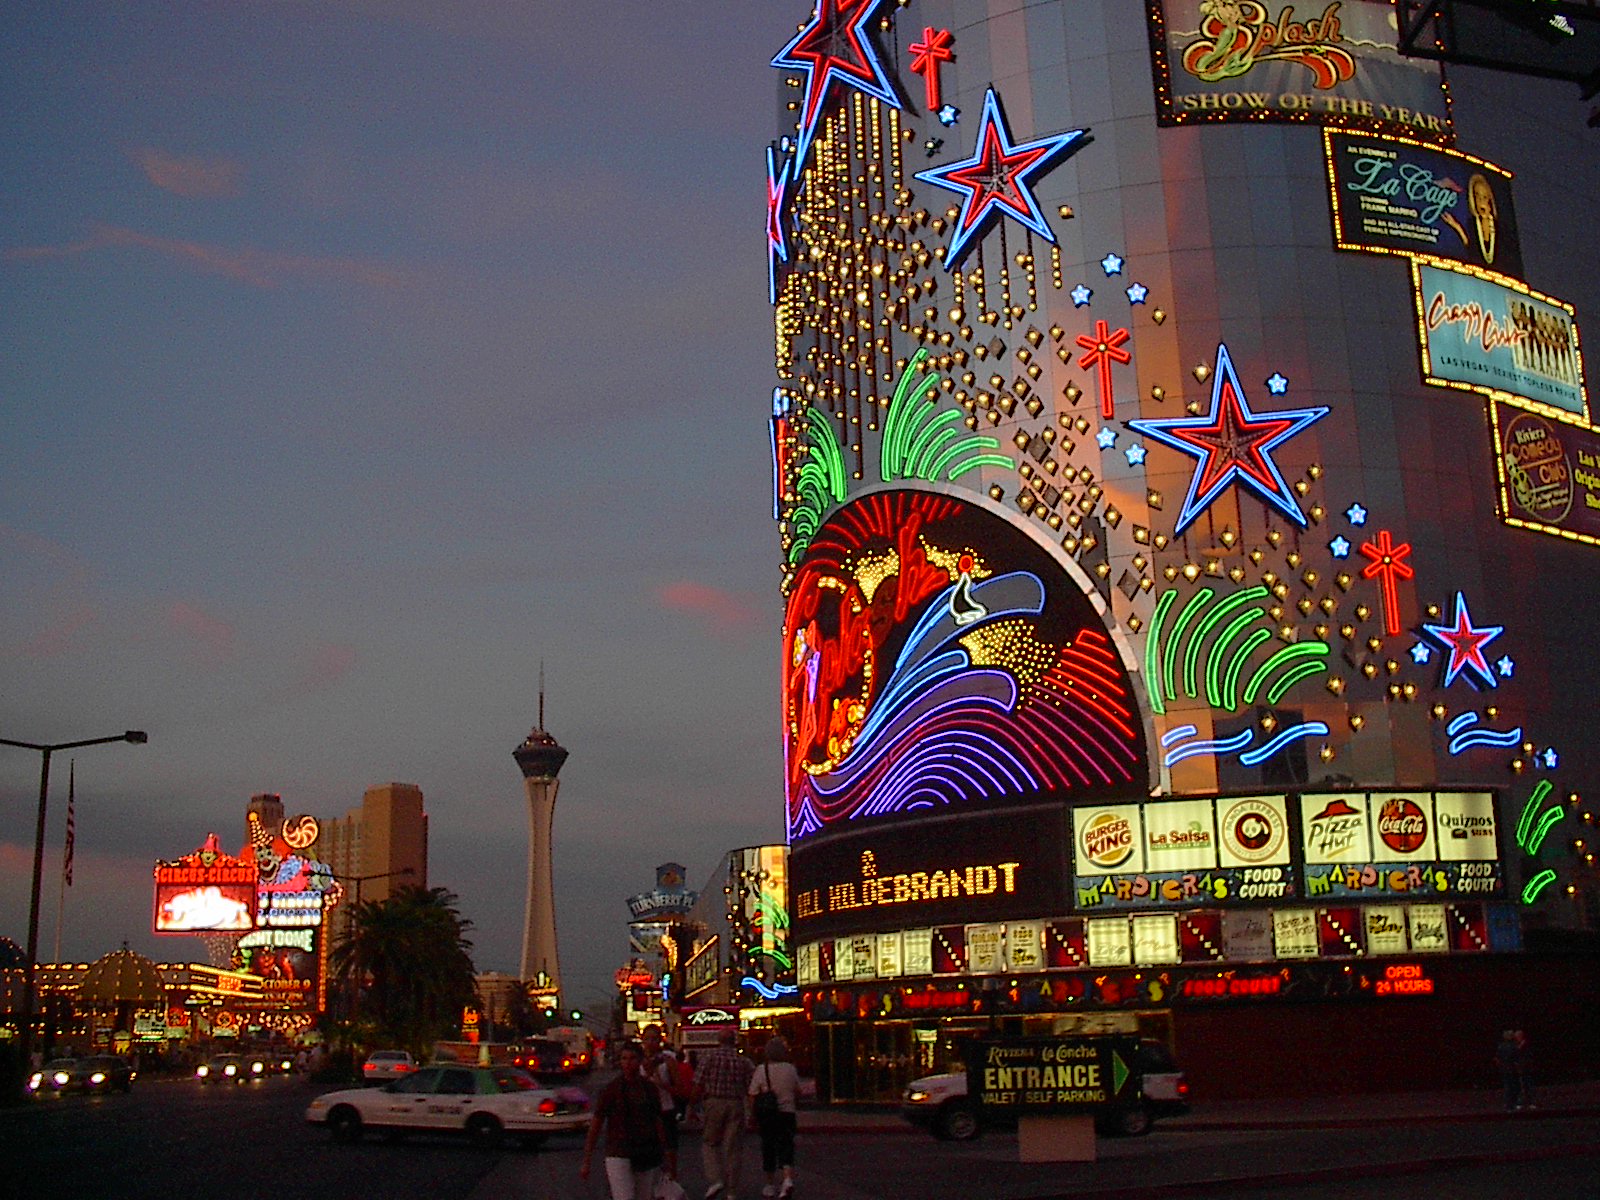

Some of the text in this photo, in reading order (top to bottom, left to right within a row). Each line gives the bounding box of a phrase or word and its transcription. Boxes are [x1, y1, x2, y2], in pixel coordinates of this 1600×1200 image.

[1279, 93, 1314, 109] OF
[1322, 96, 1374, 116] THE
[1347, 158, 1458, 224] La Cage
[1428, 291, 1483, 344] Crazy
[1441, 356, 1457, 367] LAS
[1515, 428, 1546, 444] Riviera
[1511, 439, 1560, 461] Comedy
[1539, 461, 1567, 484] Club
[1439, 812, 1493, 828] Quiznos
[1085, 818, 1129, 842] BURGER
[1149, 829, 1210, 844] La Salsa
[1308, 815, 1363, 849] Pizza
[1088, 830, 1132, 859] KING
[1318, 831, 1357, 855] Hut
[1243, 867, 1282, 883] FOOD
[1388, 864, 1448, 892] GRAS
[1460, 863, 1492, 877] FOOD
[1161, 872, 1228, 900] GRAS
[1239, 882, 1286, 898] COURT
[1457, 877, 1496, 892] COURT
[1386, 966, 1421, 979] OPEN
[1230, 976, 1281, 995] COURT
[1376, 979, 1433, 994] 24 HOURS
[1055, 1044, 1097, 1063] Concha
[985, 1065, 1100, 1090] ENTRANCE
[981, 1091, 1015, 1105] VALET
[1026, 1091, 1053, 1104] SELF
[1056, 1089, 1105, 1103] PARKING
